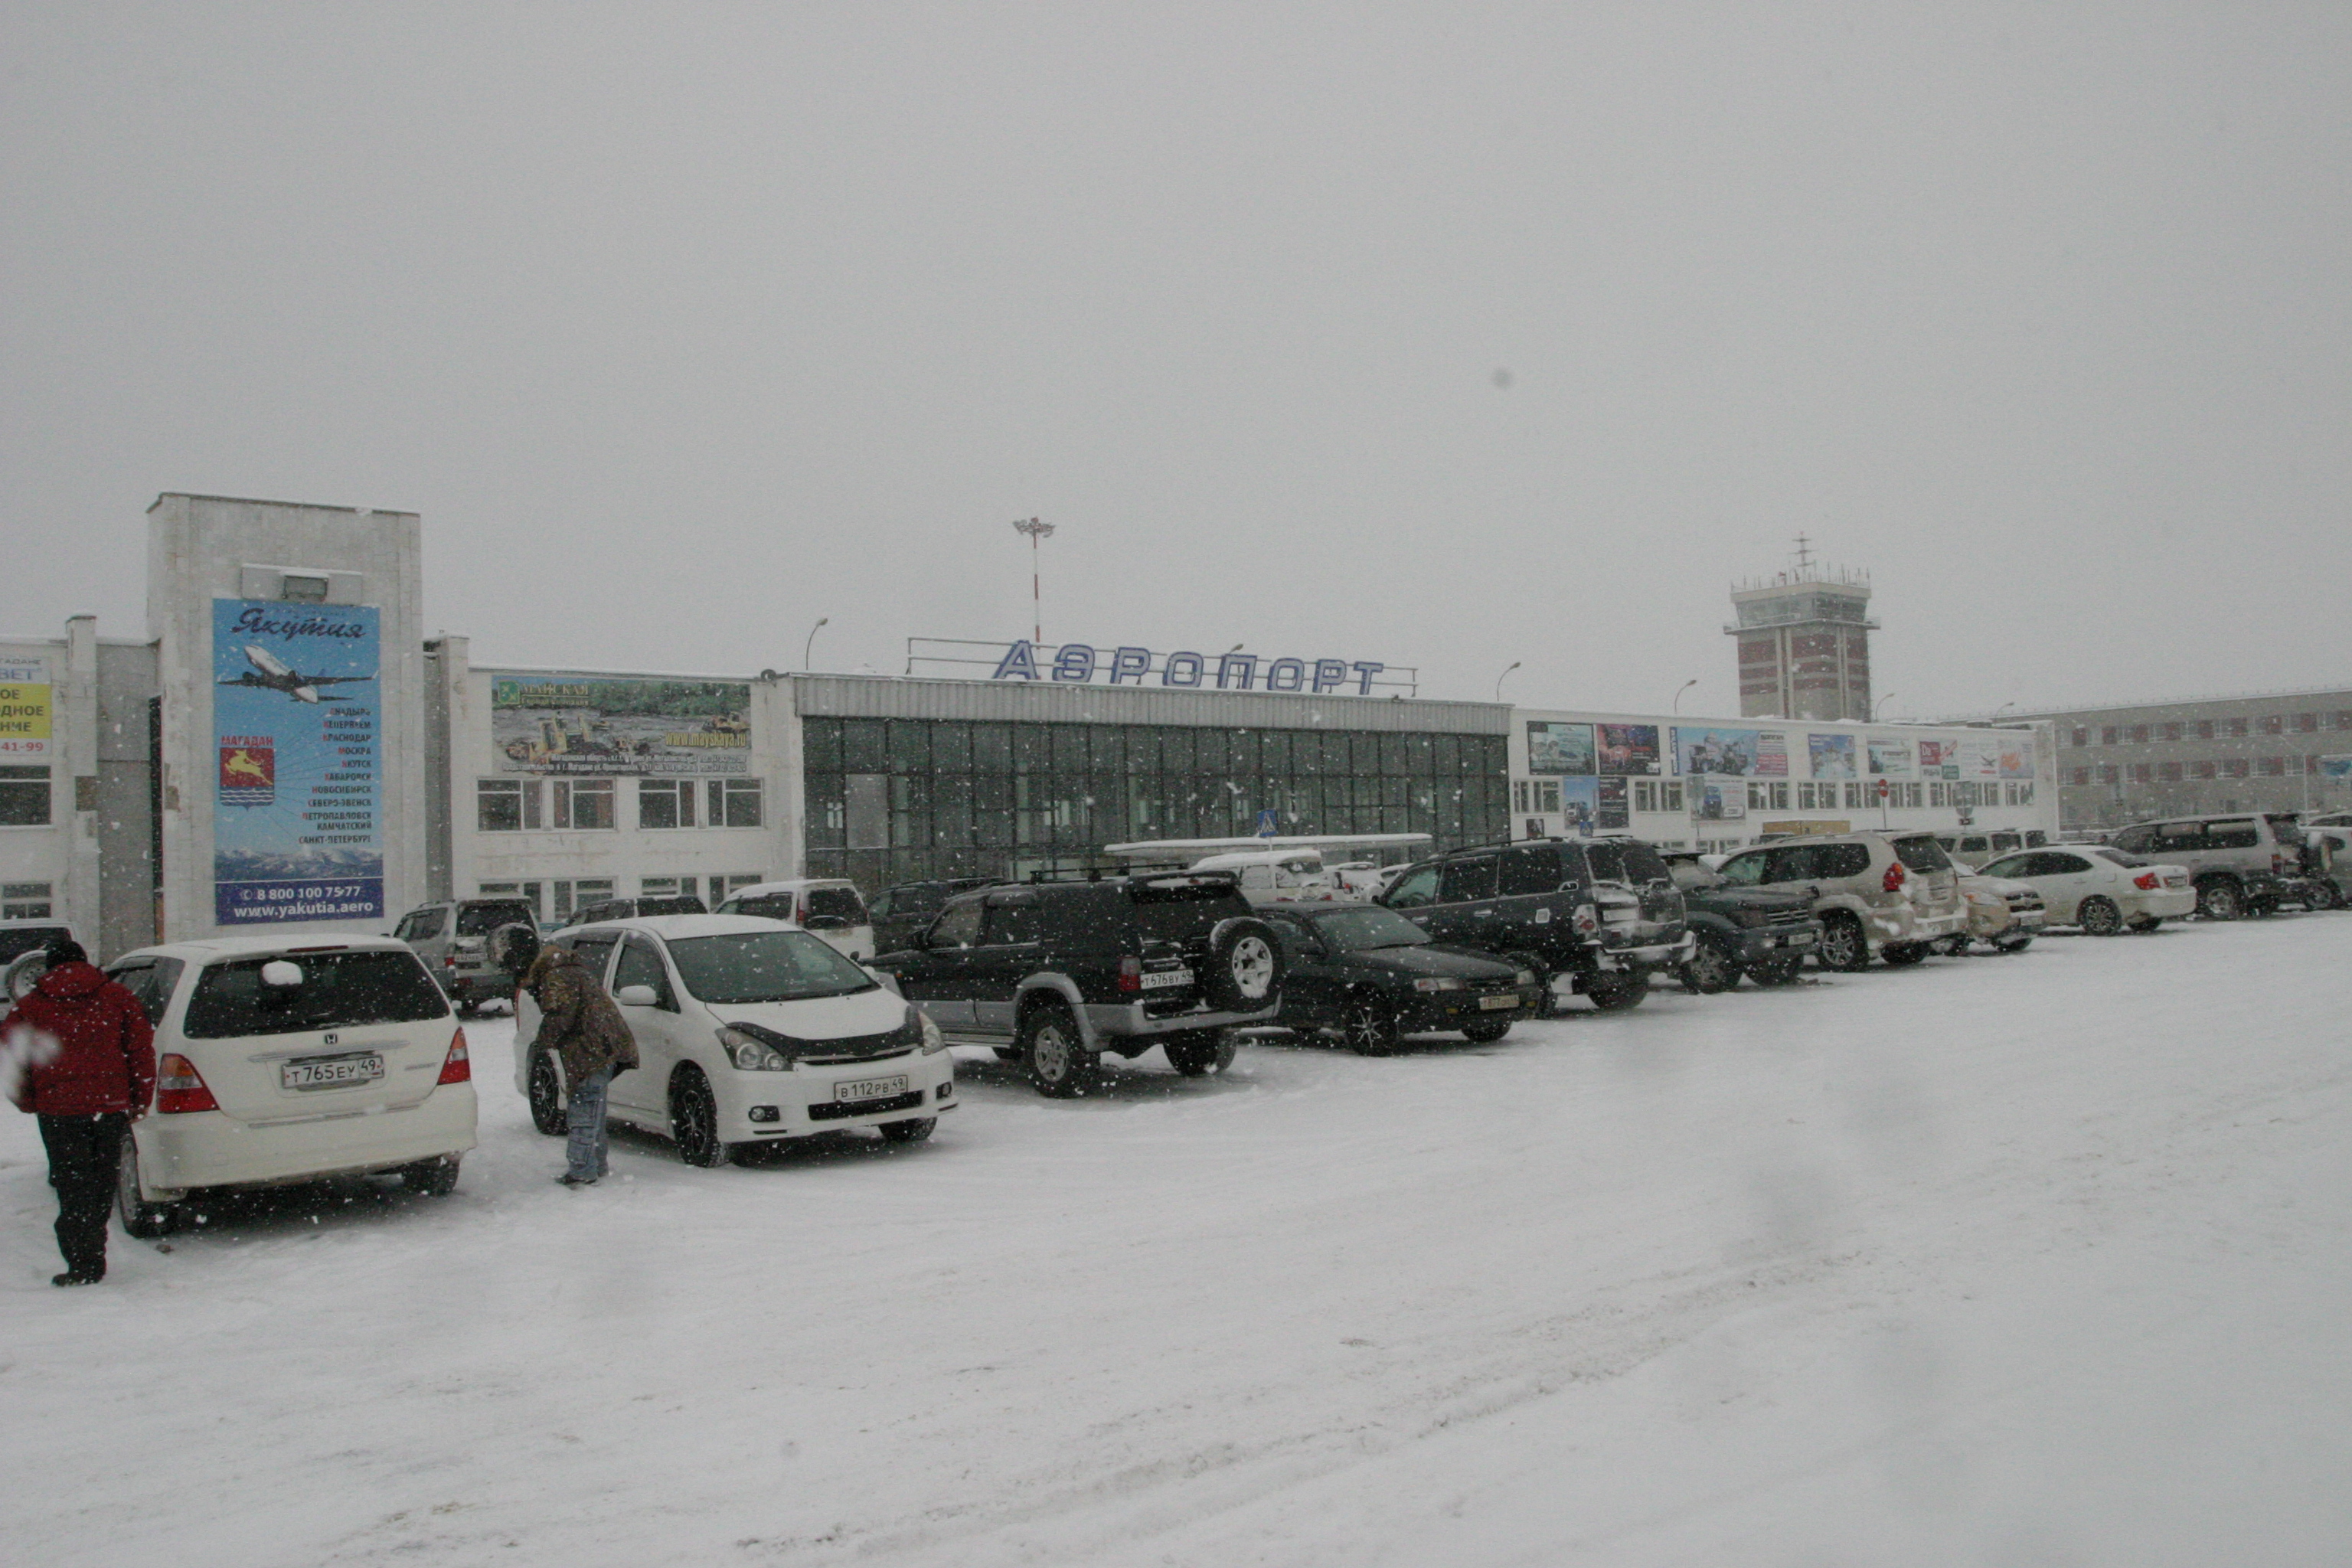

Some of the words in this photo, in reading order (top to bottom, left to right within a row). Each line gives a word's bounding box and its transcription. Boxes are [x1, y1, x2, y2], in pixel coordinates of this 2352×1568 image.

[230, 607, 366, 641] Якутия
[992, 640, 1383, 696] АЭРОПОРТ
[221, 736, 273, 747] МАГАДАН
[322, 733, 371, 743] КРАСНОДАР
[665, 731, 746, 748] www.mayskaya.ru
[338, 746, 372, 755] МОСКВА
[341, 760, 372, 768] ЯКУТСК
[325, 773, 372, 781] ХАБАРОВСК
[312, 786, 372, 794] НОВОСИБИРСК
[299, 835, 371, 844] САНКТ-ПЕТЕРБУРГ
[257, 889, 266, 900] 8
[270, 888, 295, 900] 800
[298, 887, 322, 899] 100
[234, 901, 374, 918] www.yakutia.aero
